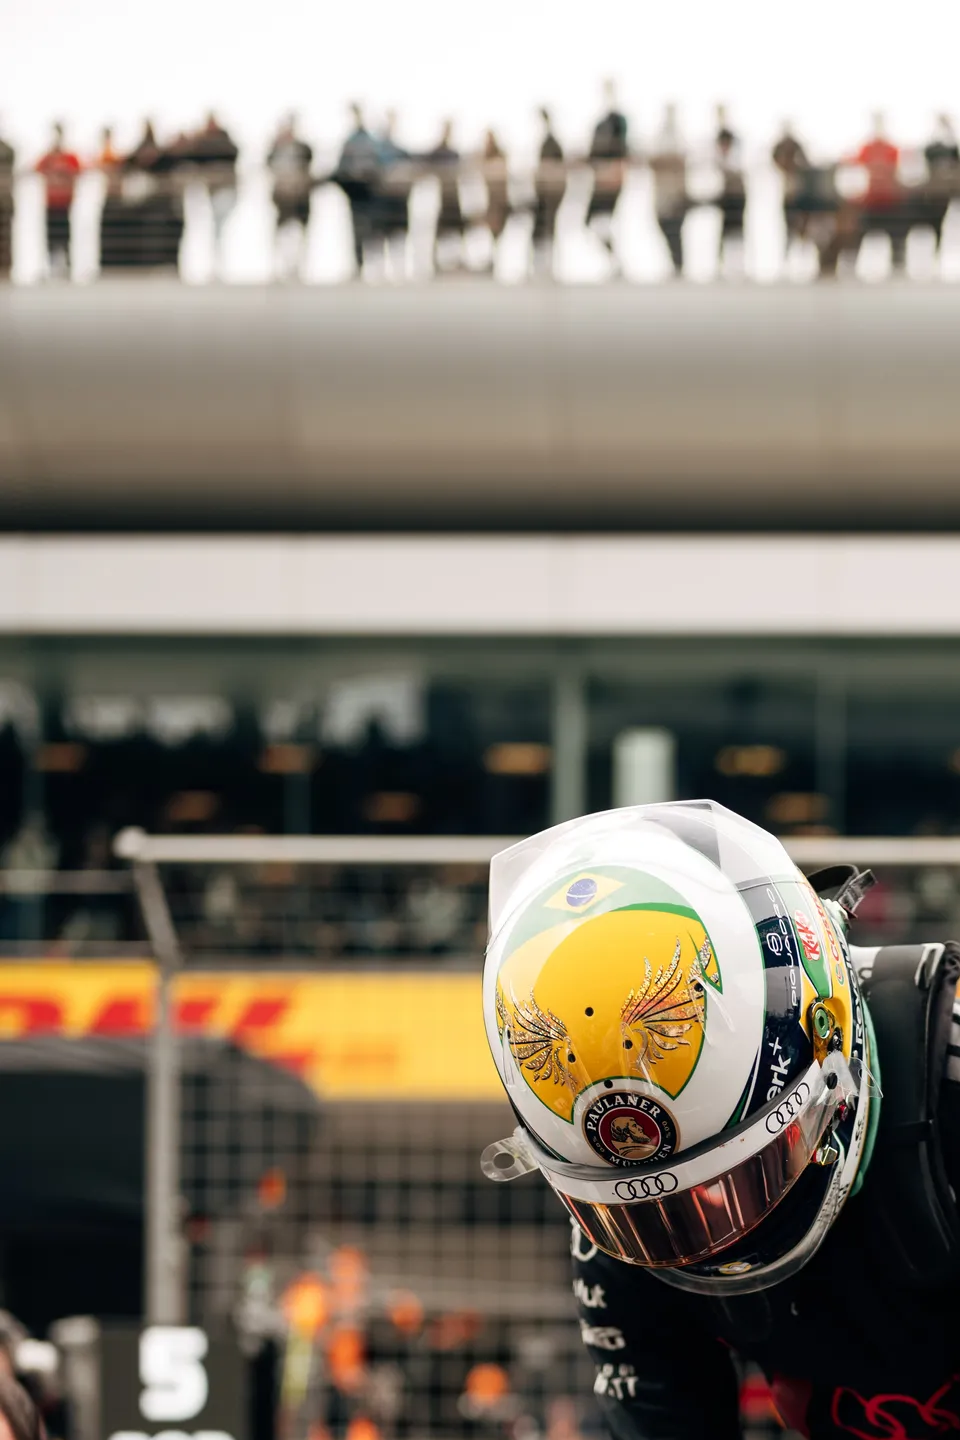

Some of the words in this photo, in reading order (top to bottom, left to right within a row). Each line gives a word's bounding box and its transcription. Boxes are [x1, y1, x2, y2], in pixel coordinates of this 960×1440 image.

[766, 887, 799, 1006] PIQUADRO
[587, 1095, 661, 1131] PAULANER
[138, 1326, 209, 1422] 5
